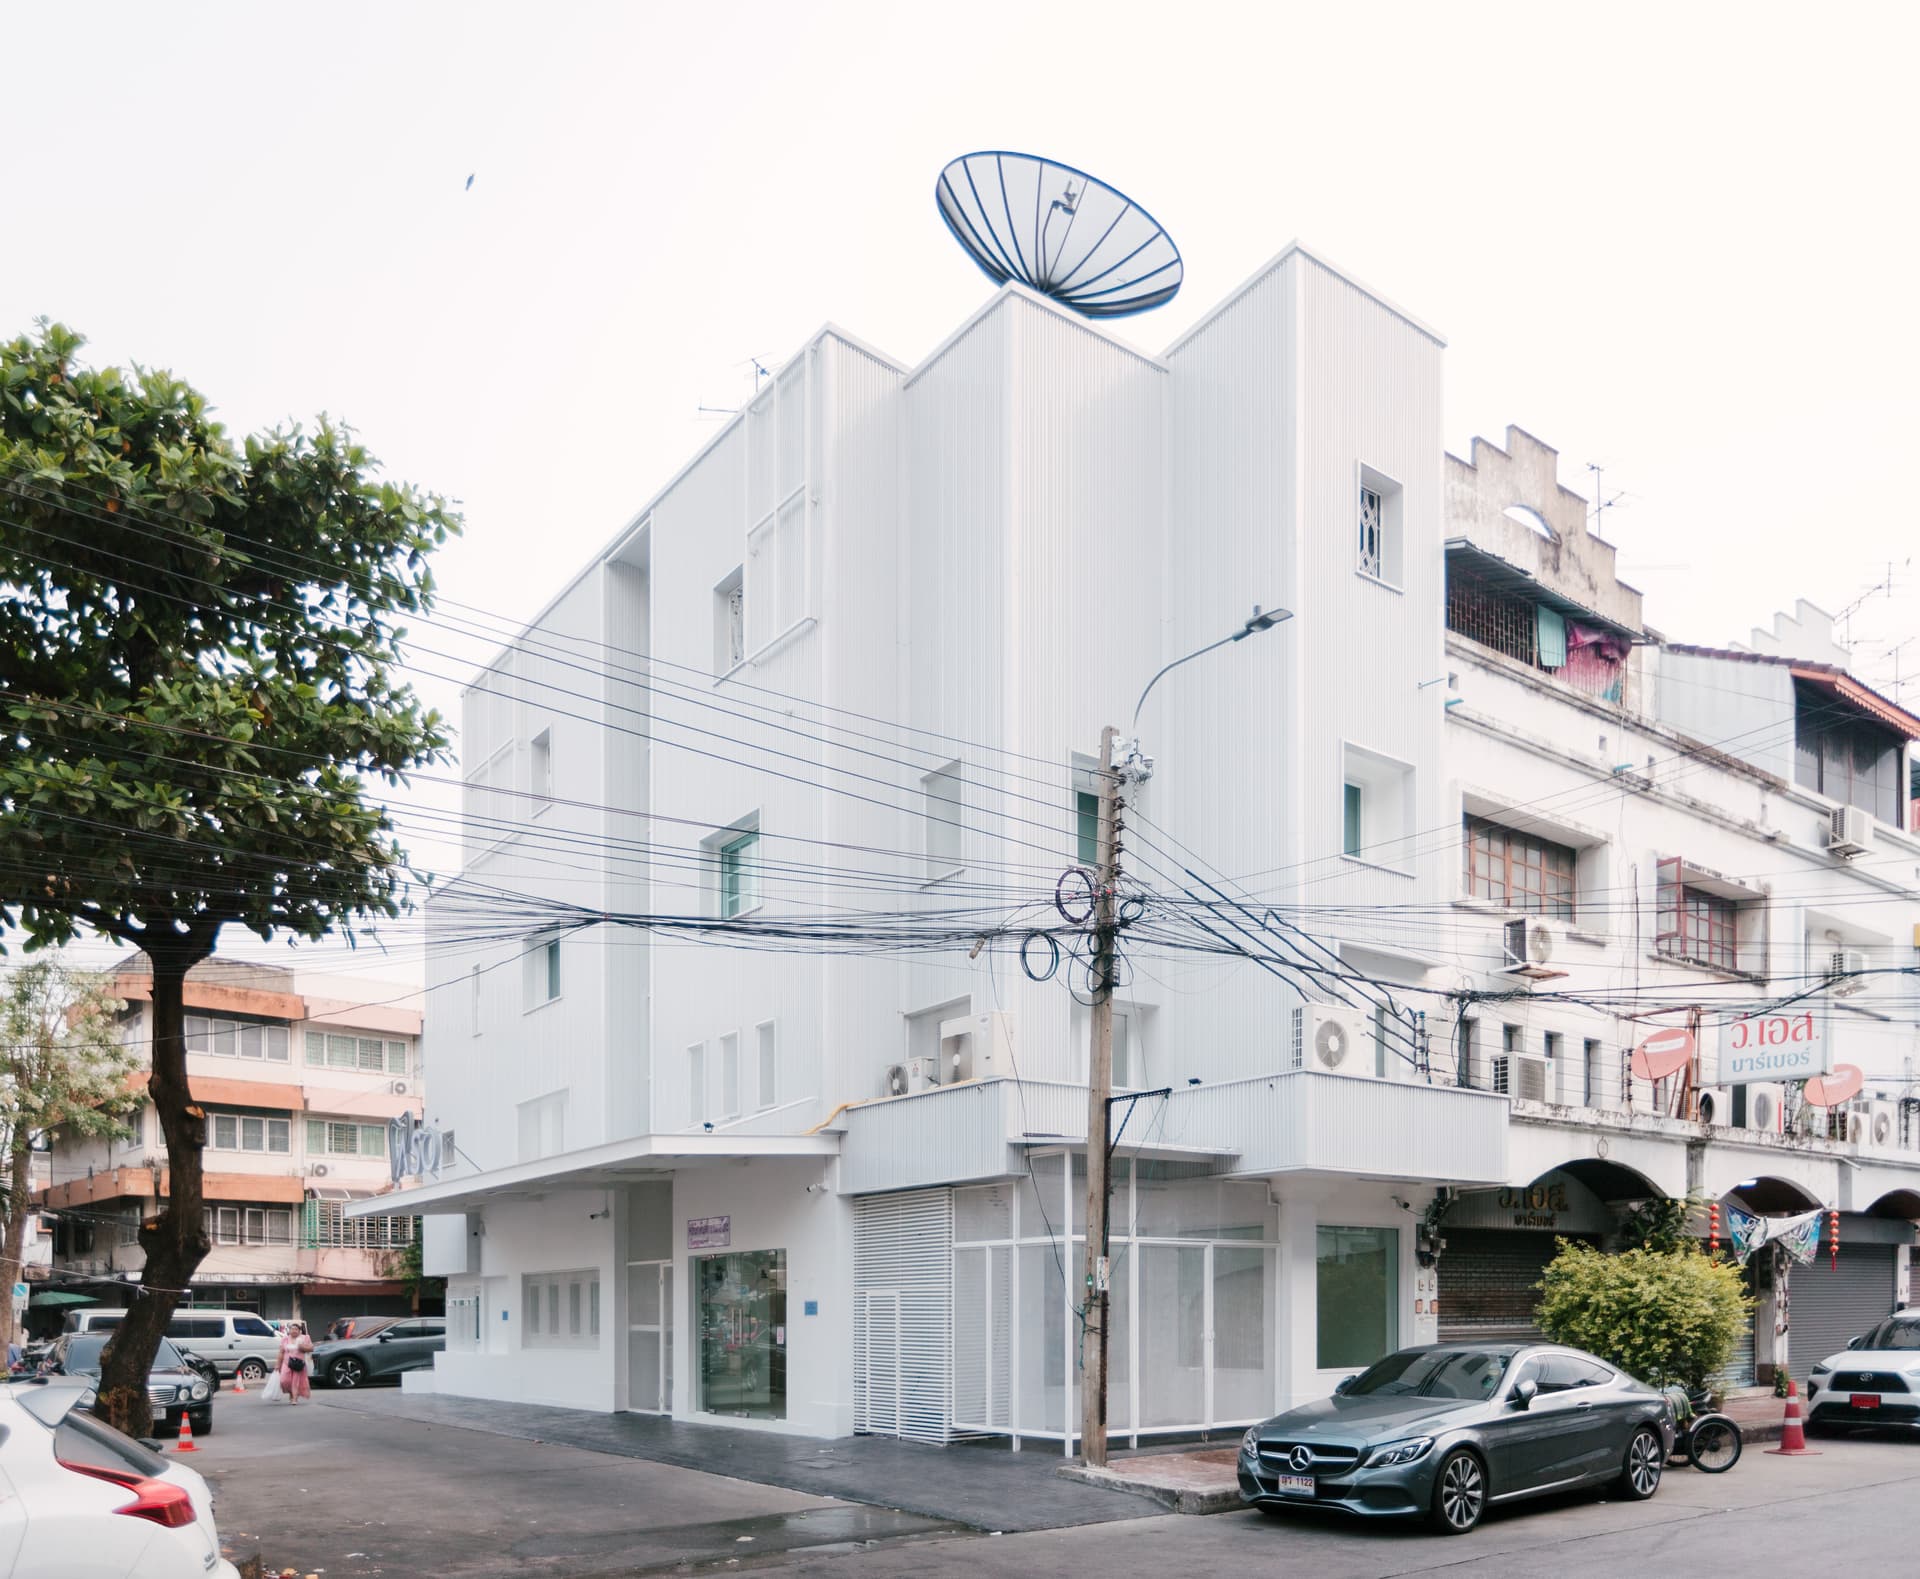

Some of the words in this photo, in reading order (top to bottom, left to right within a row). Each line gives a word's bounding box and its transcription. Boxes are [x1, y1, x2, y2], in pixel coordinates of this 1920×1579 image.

[1732, 1047, 1811, 1073] บาร์เบอร์
[1296, 1477, 1313, 1487] 1122
